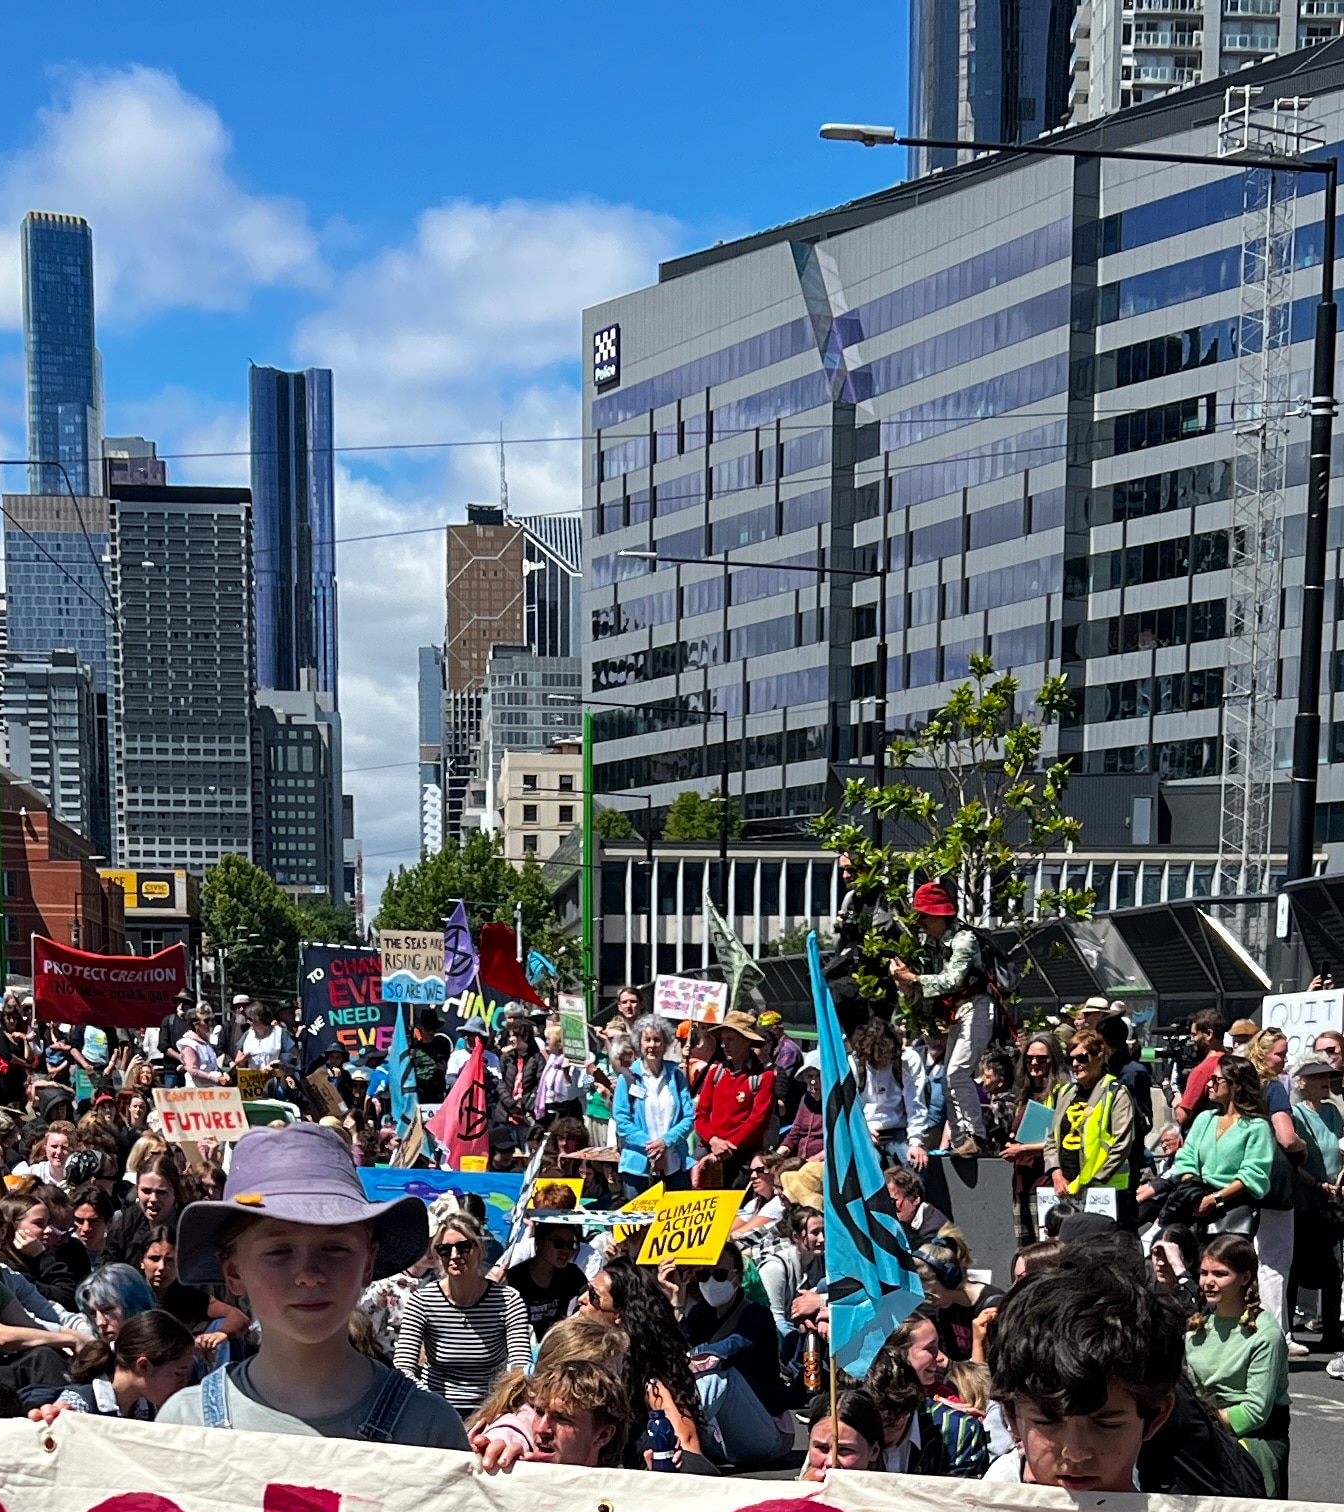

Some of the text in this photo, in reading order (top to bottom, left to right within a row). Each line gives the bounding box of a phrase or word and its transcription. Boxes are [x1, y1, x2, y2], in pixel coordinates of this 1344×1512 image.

[384, 936, 444, 950] THE SEAS ARE
[43, 959, 176, 982] PROTECT CREATION
[330, 957, 382, 976] CHAN
[384, 954, 444, 972] RISING AND
[306, 967, 325, 984] TO
[327, 975, 383, 1007] EVE
[386, 982, 444, 1000] SO ARE WE
[307, 1006, 381, 1036] WE NEED
[1270, 999, 1336, 1027] QUIT
[336, 1026, 395, 1056] EVE
[162, 1111, 243, 1133] FUTURE!
[657, 1196, 719, 1223] CLIMATE
[661, 1210, 716, 1234] ACTION
[647, 1224, 713, 1259] NOW
